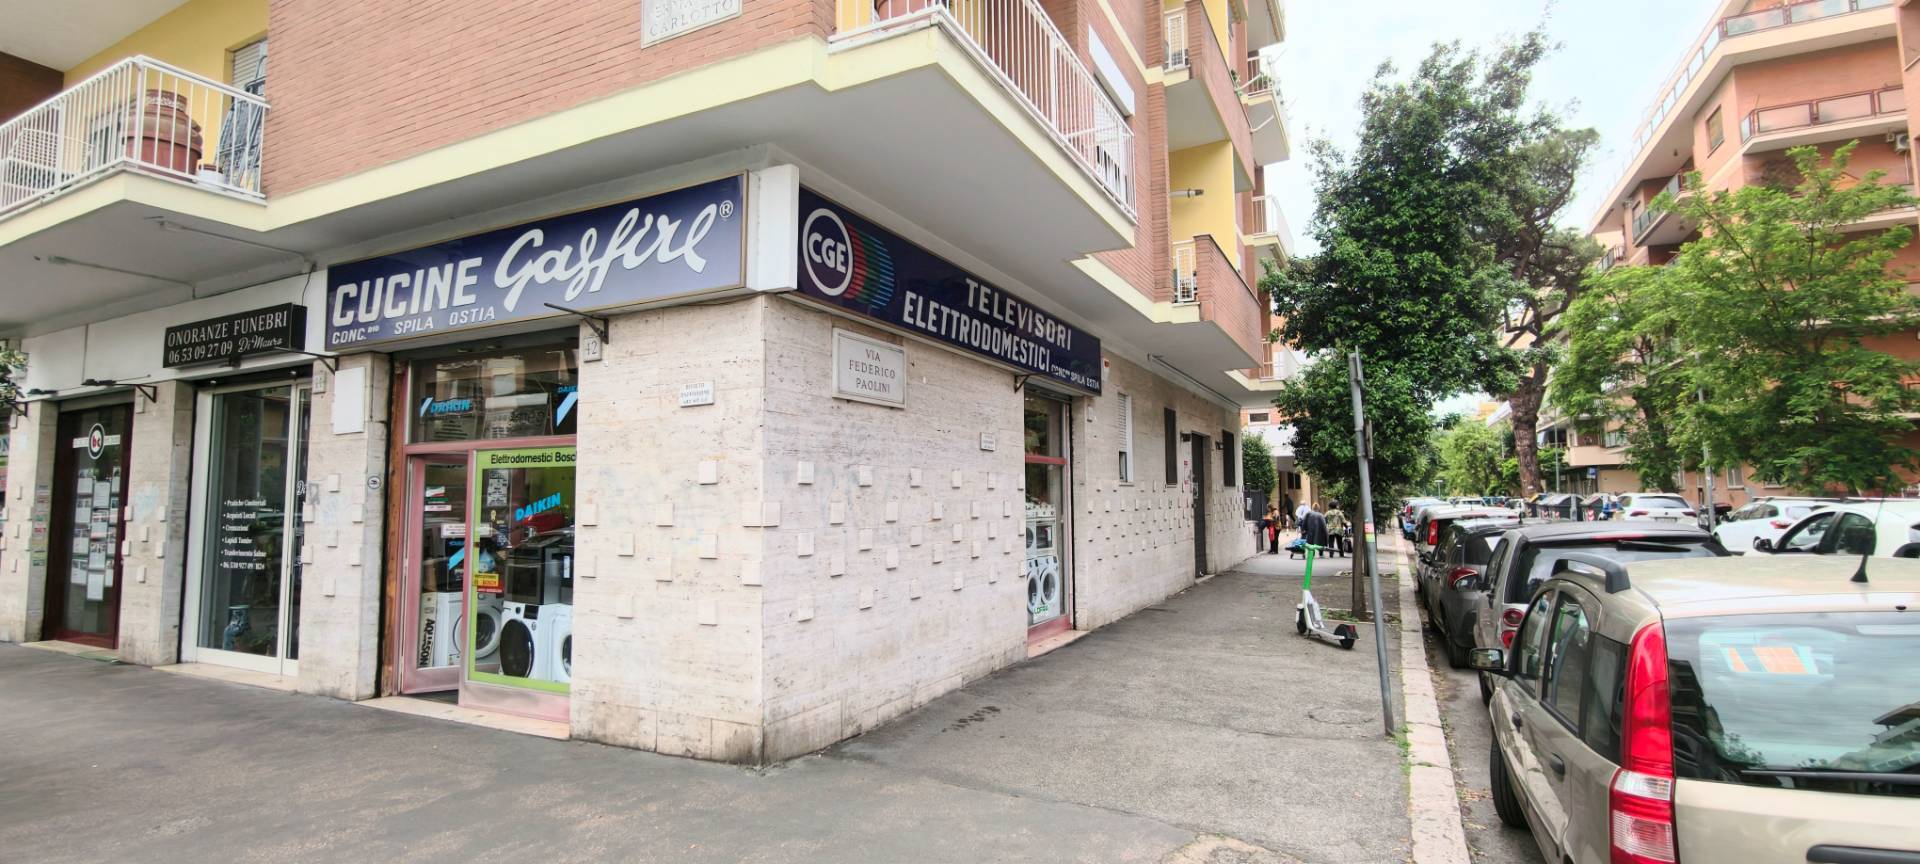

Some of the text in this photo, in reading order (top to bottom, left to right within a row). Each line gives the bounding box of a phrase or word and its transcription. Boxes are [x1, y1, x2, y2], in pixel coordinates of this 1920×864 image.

[808, 232, 847, 274] CGE
[331, 256, 483, 328] CUCINE
[167, 310, 288, 348] ONORANZE FUNEBRI
[393, 316, 435, 336] SPILA
[448, 305, 496, 326] OSTIA
[965, 277, 1072, 351] TELEVISORI
[903, 290, 1051, 373] ELETTRODOMESTICI
[168, 350, 180, 364] 06
[181, 347, 193, 361] 53
[194, 345, 206, 360] 09
[207, 343, 219, 358] 27
[220, 340, 233, 356] 09
[865, 348, 881, 362] VIA
[849, 359, 896, 379] FEDERICO
[856, 377, 890, 394] PAOLINI
[490, 451, 576, 465] Elettrodomestici Bosc
[514, 492, 561, 522] DAIKIN
